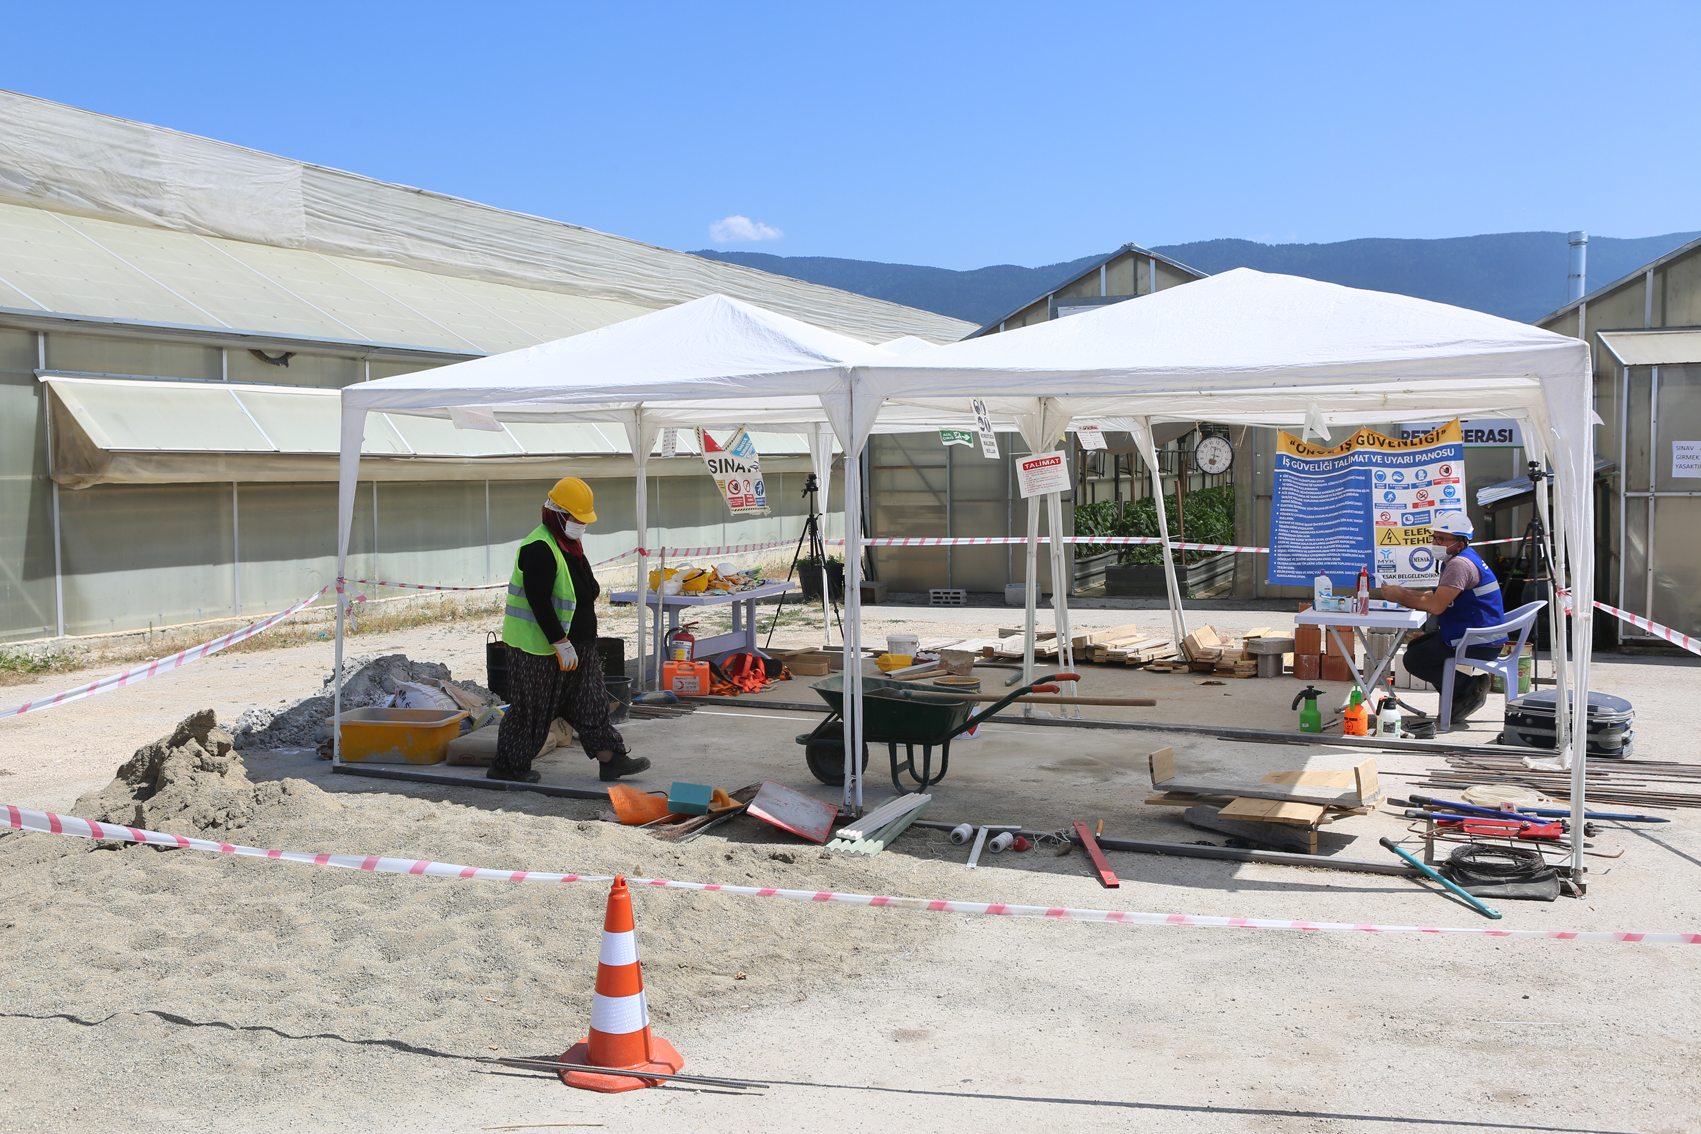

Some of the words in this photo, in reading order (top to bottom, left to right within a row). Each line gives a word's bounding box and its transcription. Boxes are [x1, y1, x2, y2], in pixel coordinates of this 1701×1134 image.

[1462, 429, 1513, 443] ERASI
[1025, 458, 1060, 469] TALİMAT
[1282, 455, 1290, 468] İŞ
[1334, 453, 1370, 469] TALİMAT
[1370, 453, 1383, 463] VE
[1385, 455, 1414, 464] UYARI
[1415, 448, 1455, 461] PANOSU
